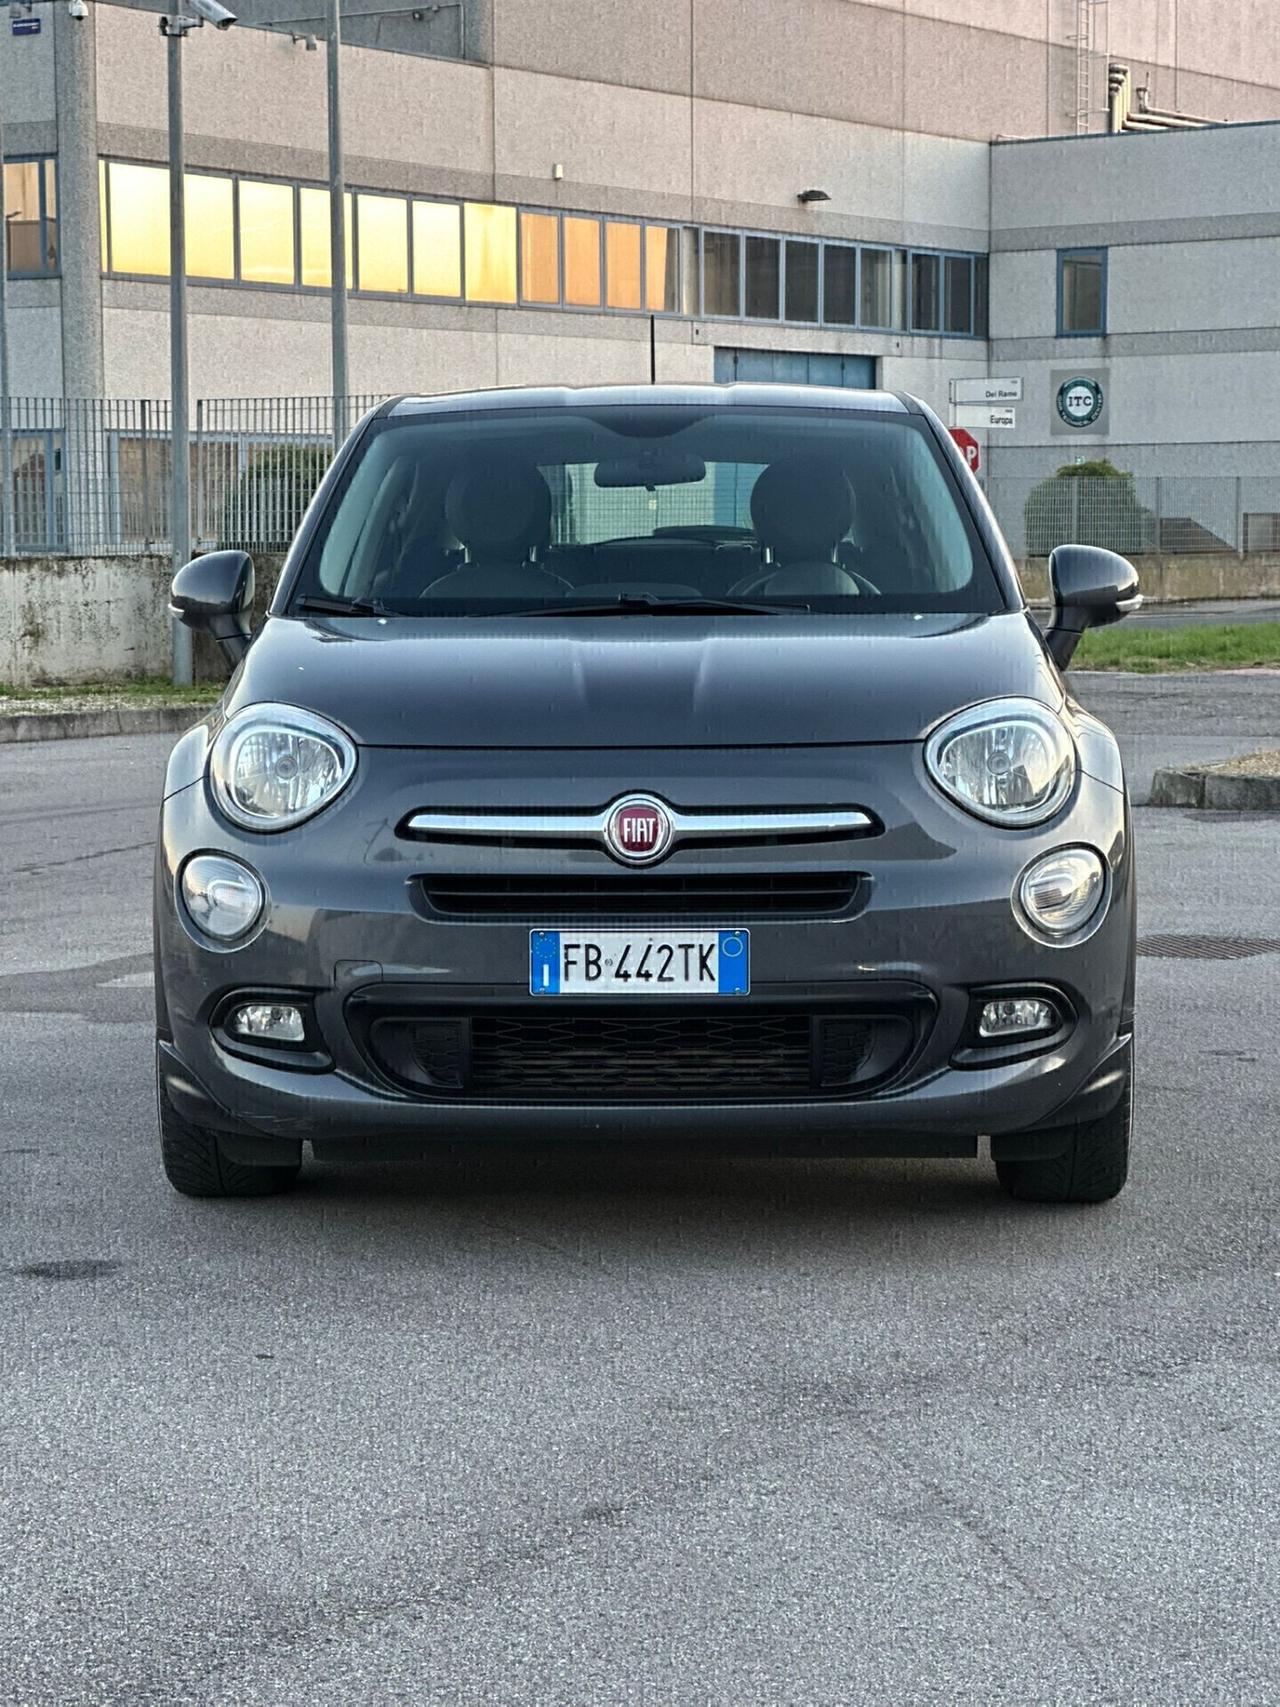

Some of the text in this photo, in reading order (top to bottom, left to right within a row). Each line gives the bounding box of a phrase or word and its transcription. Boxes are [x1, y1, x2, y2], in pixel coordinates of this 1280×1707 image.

[1068, 395, 1092, 407] ITC
[990, 415, 1013, 425] Europa
[623, 817, 656, 843] FIAT
